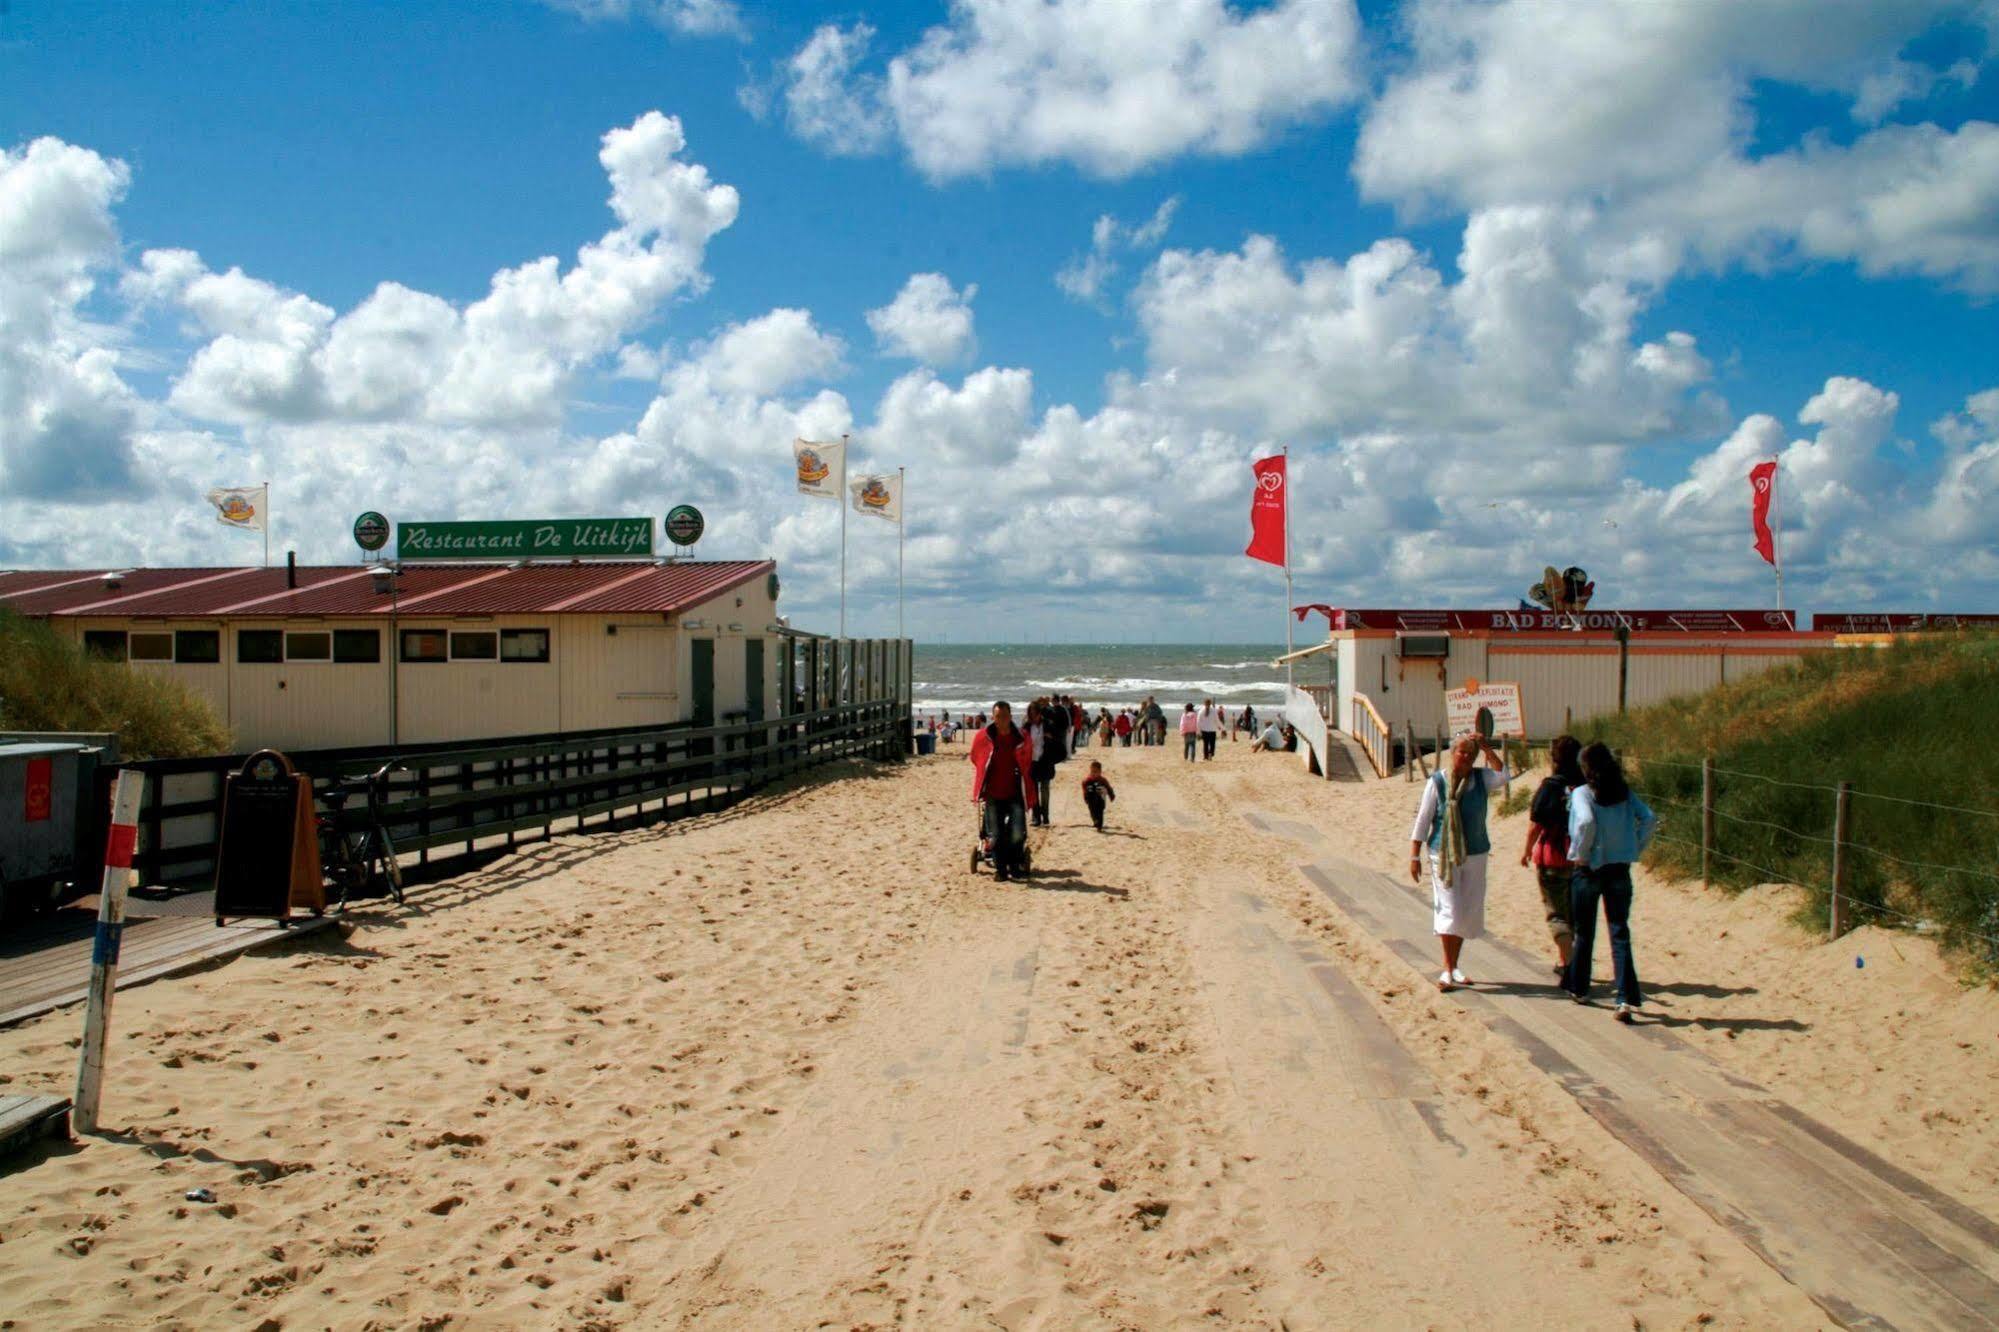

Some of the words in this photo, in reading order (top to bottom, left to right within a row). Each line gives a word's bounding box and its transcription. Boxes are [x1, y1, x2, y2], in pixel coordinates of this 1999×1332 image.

[401, 527, 523, 549] Restaurant
[534, 526, 561, 547] De
[572, 521, 649, 553] Uitkijk
[1491, 614, 1535, 628] BAD
[1541, 614, 1633, 628] EGMOND
